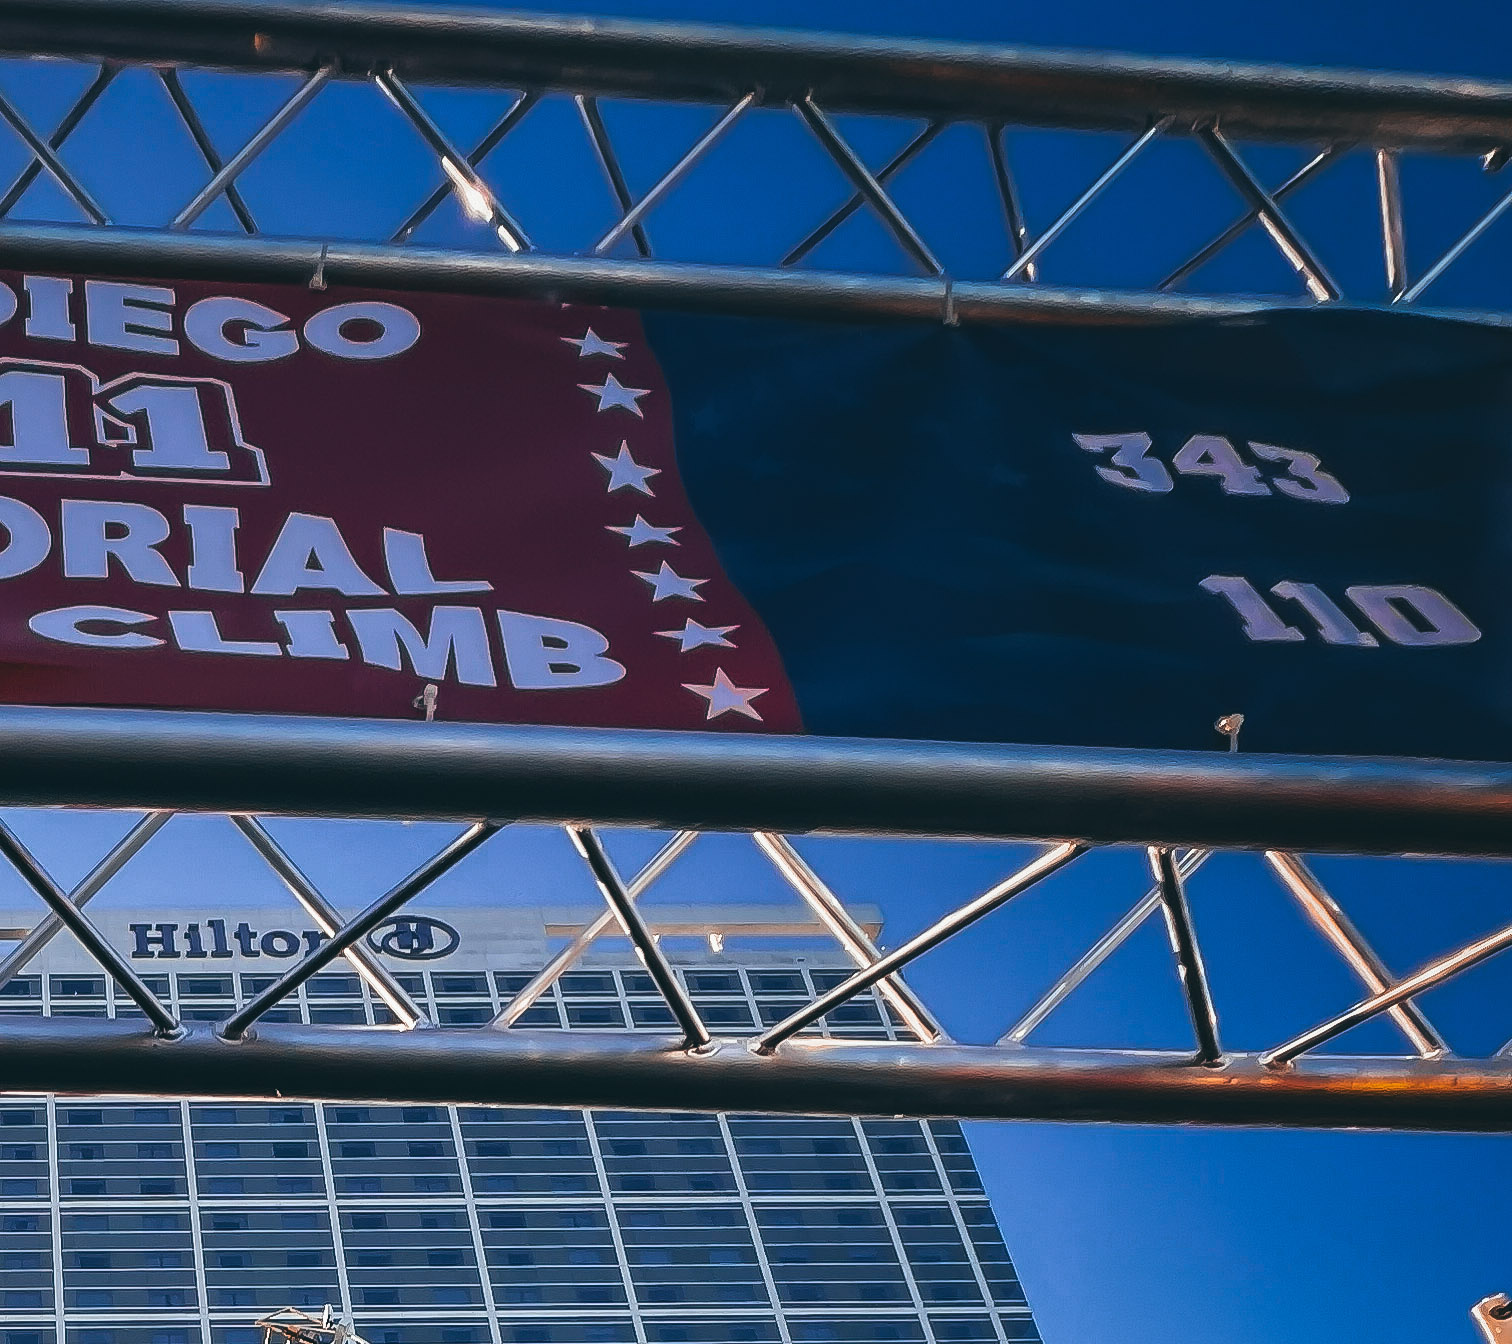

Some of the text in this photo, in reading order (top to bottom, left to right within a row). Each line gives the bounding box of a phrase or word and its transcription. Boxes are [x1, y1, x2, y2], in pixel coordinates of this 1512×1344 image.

[1071, 431, 1351, 504] 343
[1198, 573, 1482, 647] 110
[28, 604, 627, 691] CLIMB
